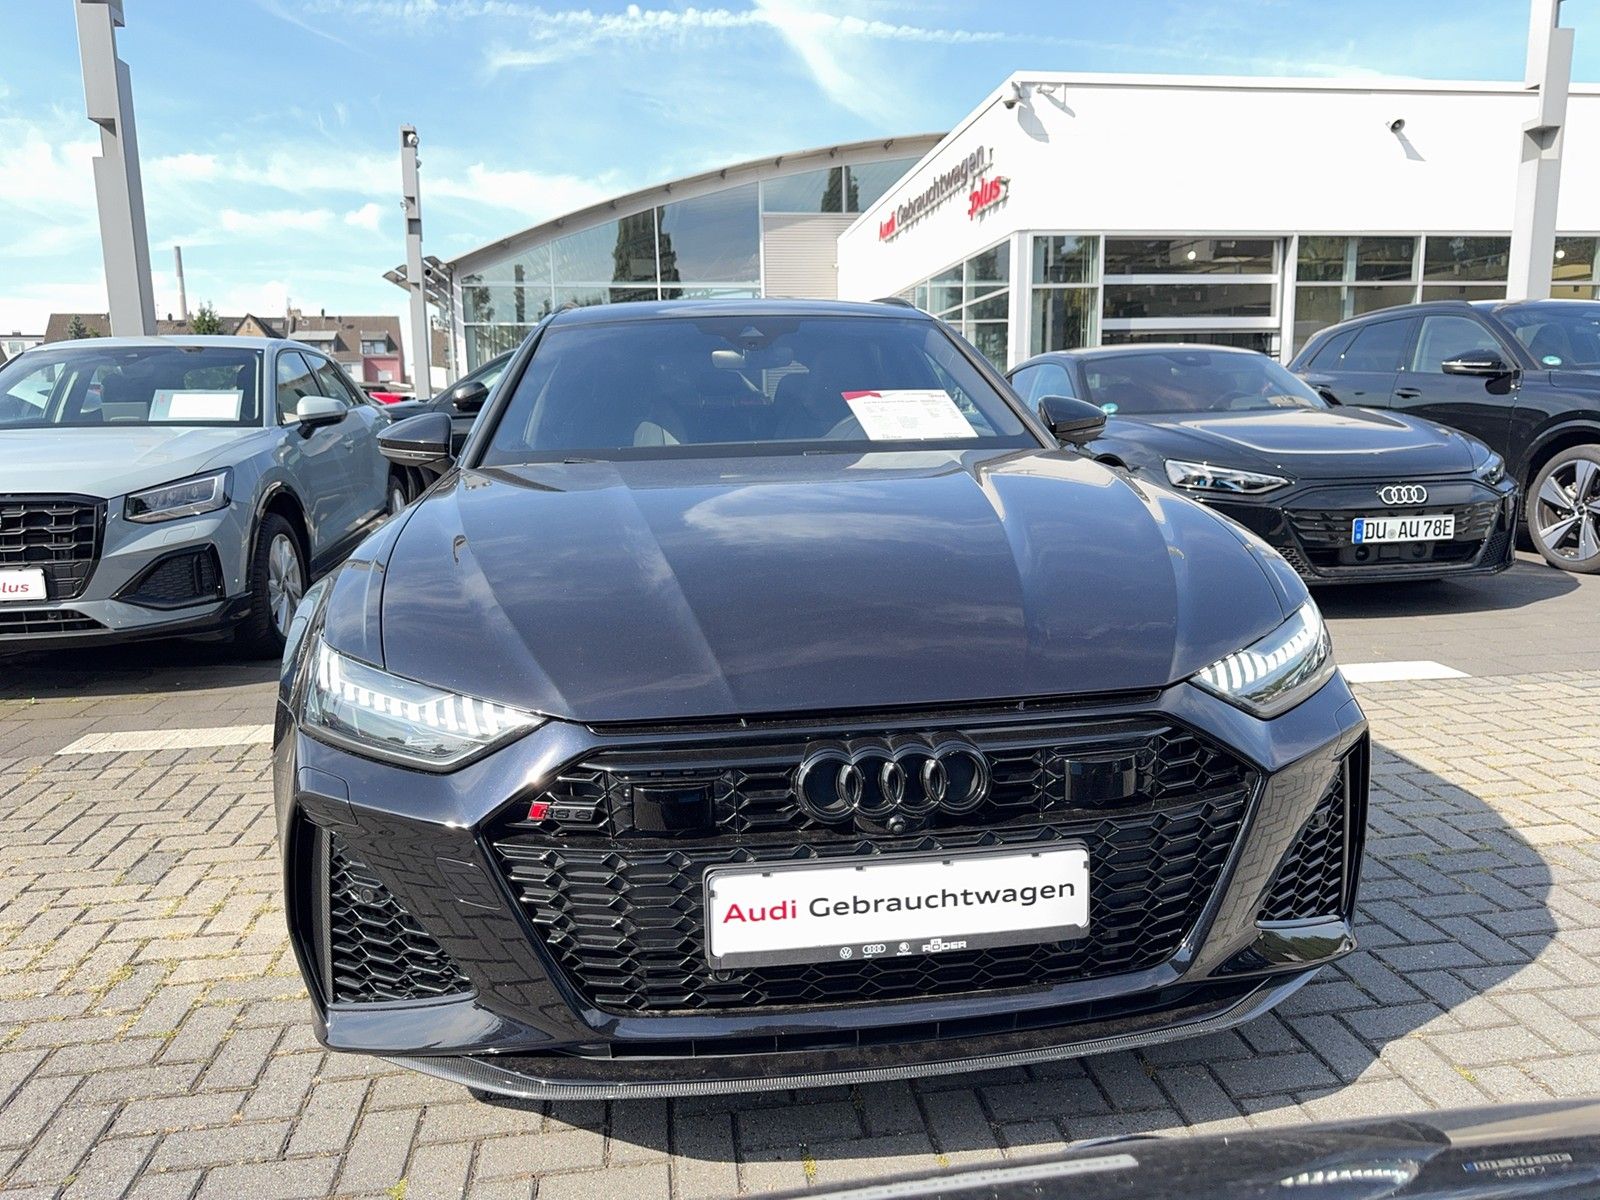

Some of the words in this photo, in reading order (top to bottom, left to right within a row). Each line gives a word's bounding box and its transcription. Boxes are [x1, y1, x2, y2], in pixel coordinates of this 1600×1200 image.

[879, 211, 896, 242] Audi
[896, 145, 985, 227] Gebrauchtwagen
[968, 176, 1002, 221] plus
[1365, 522, 1387, 540] DU
[1398, 520, 1420, 539] AU
[1423, 519, 1453, 538] 78E
[1, 582, 30, 593] lus
[723, 899, 798, 924] Audi
[808, 882, 1076, 919] Gebrauchtwagen
